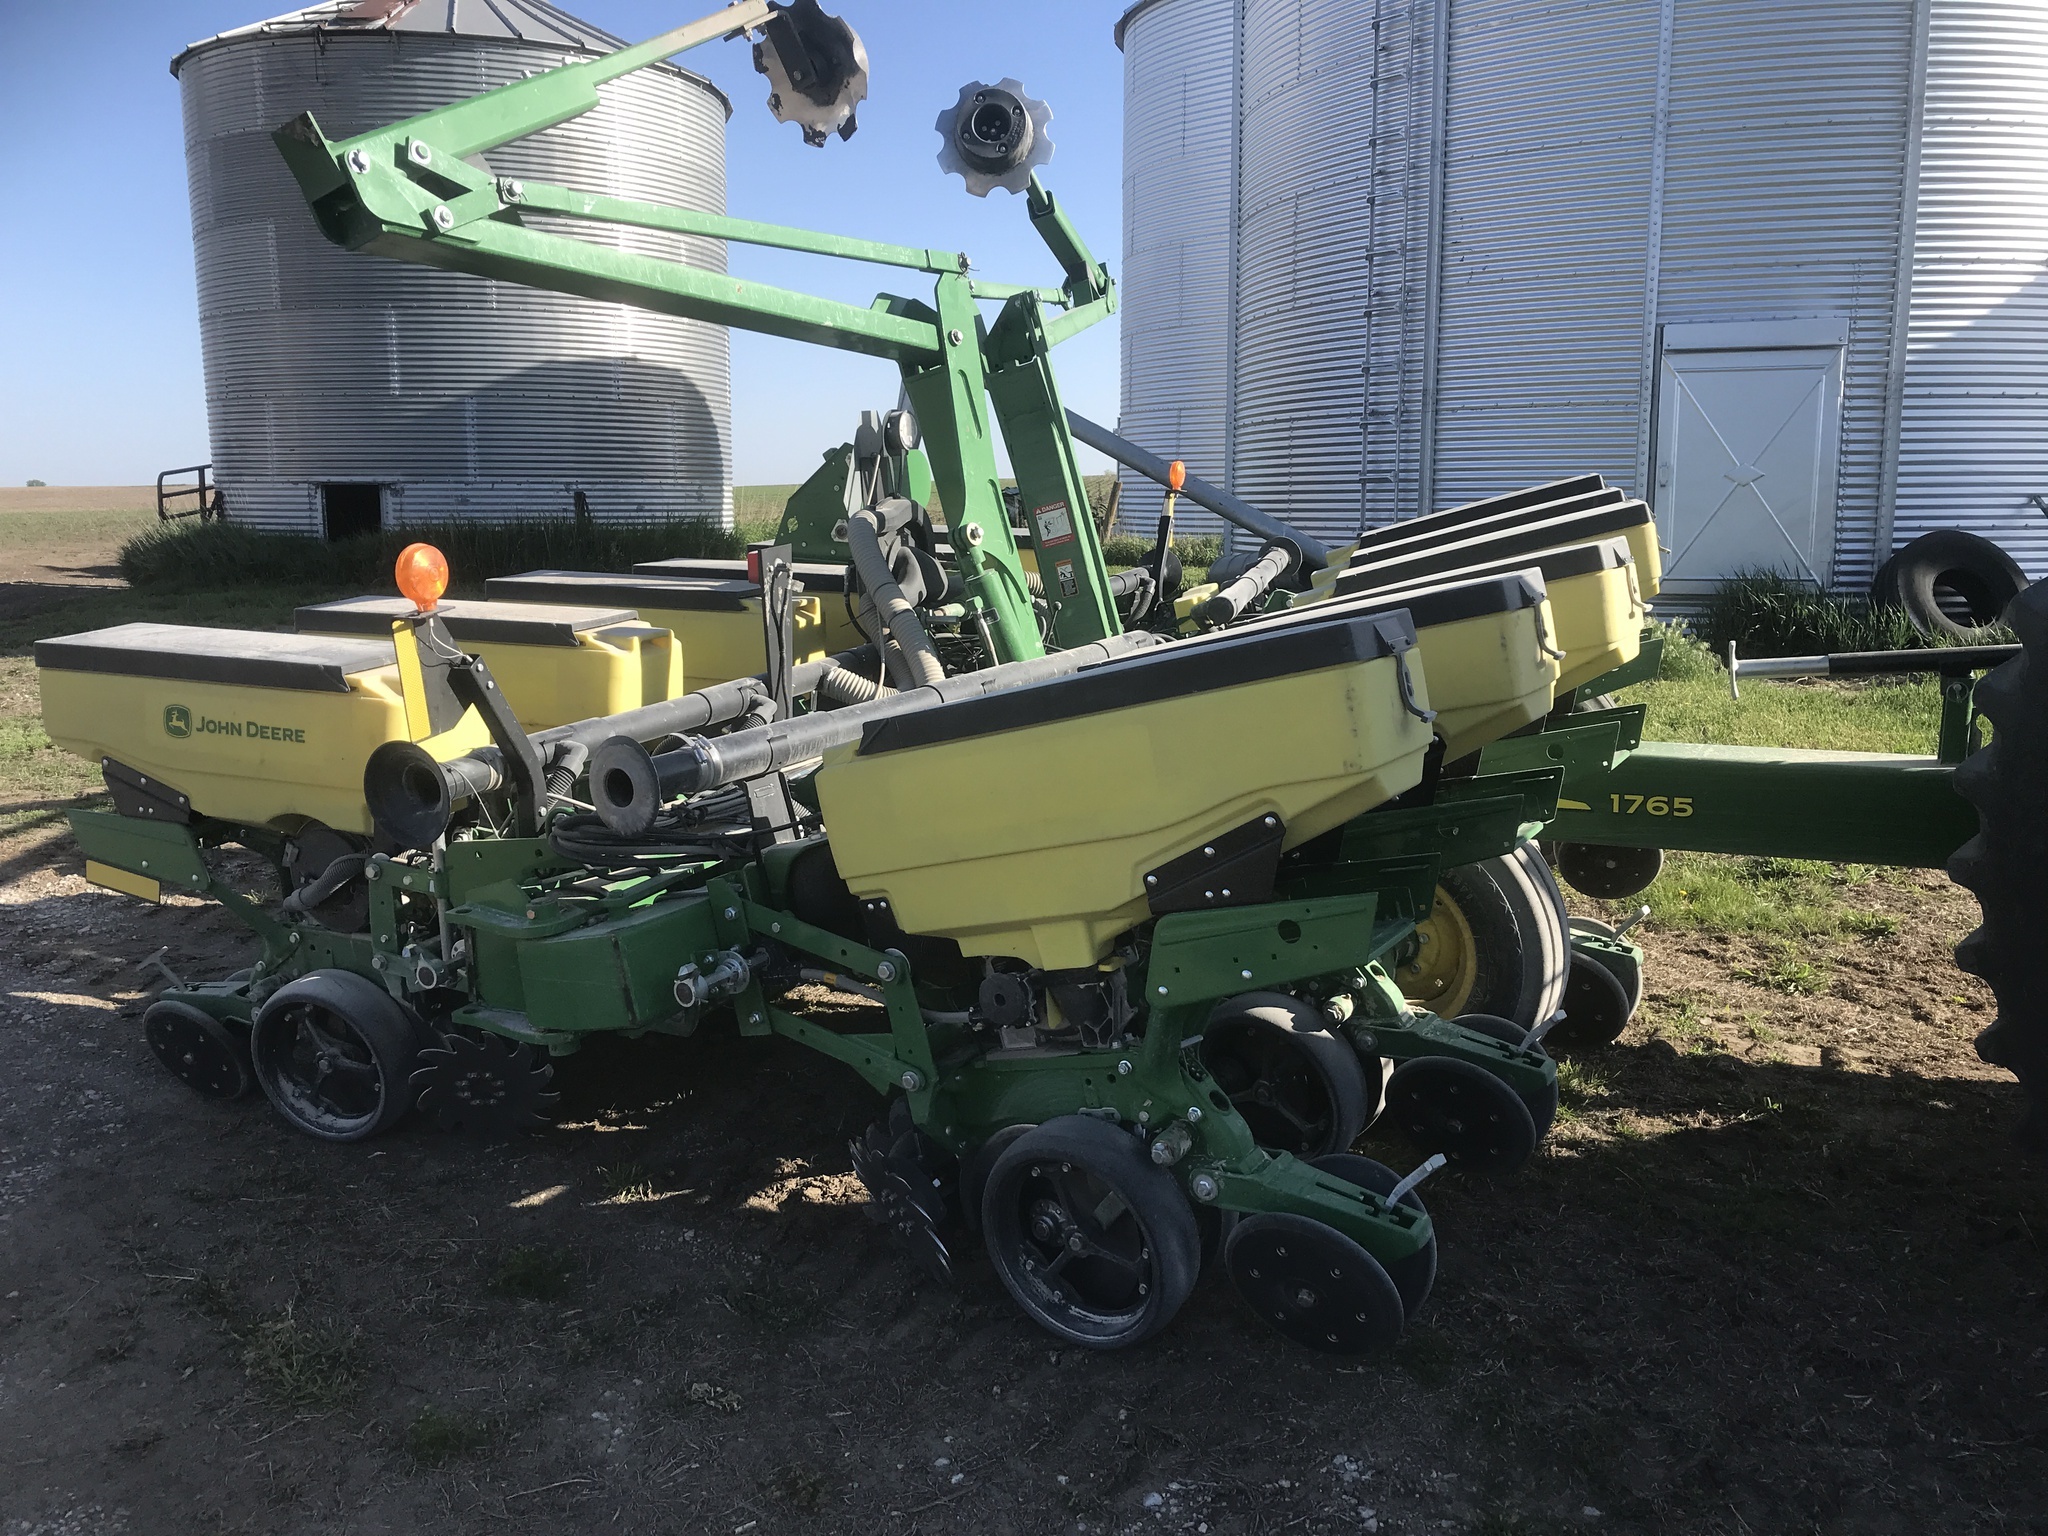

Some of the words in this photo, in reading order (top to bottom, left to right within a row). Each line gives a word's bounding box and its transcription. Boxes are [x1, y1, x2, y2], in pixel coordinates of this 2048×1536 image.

[1041, 501, 1065, 513] DANGER
[195, 716, 242, 737] JOHN
[246, 721, 306, 744] DEERE
[1610, 793, 1694, 818] 1765
